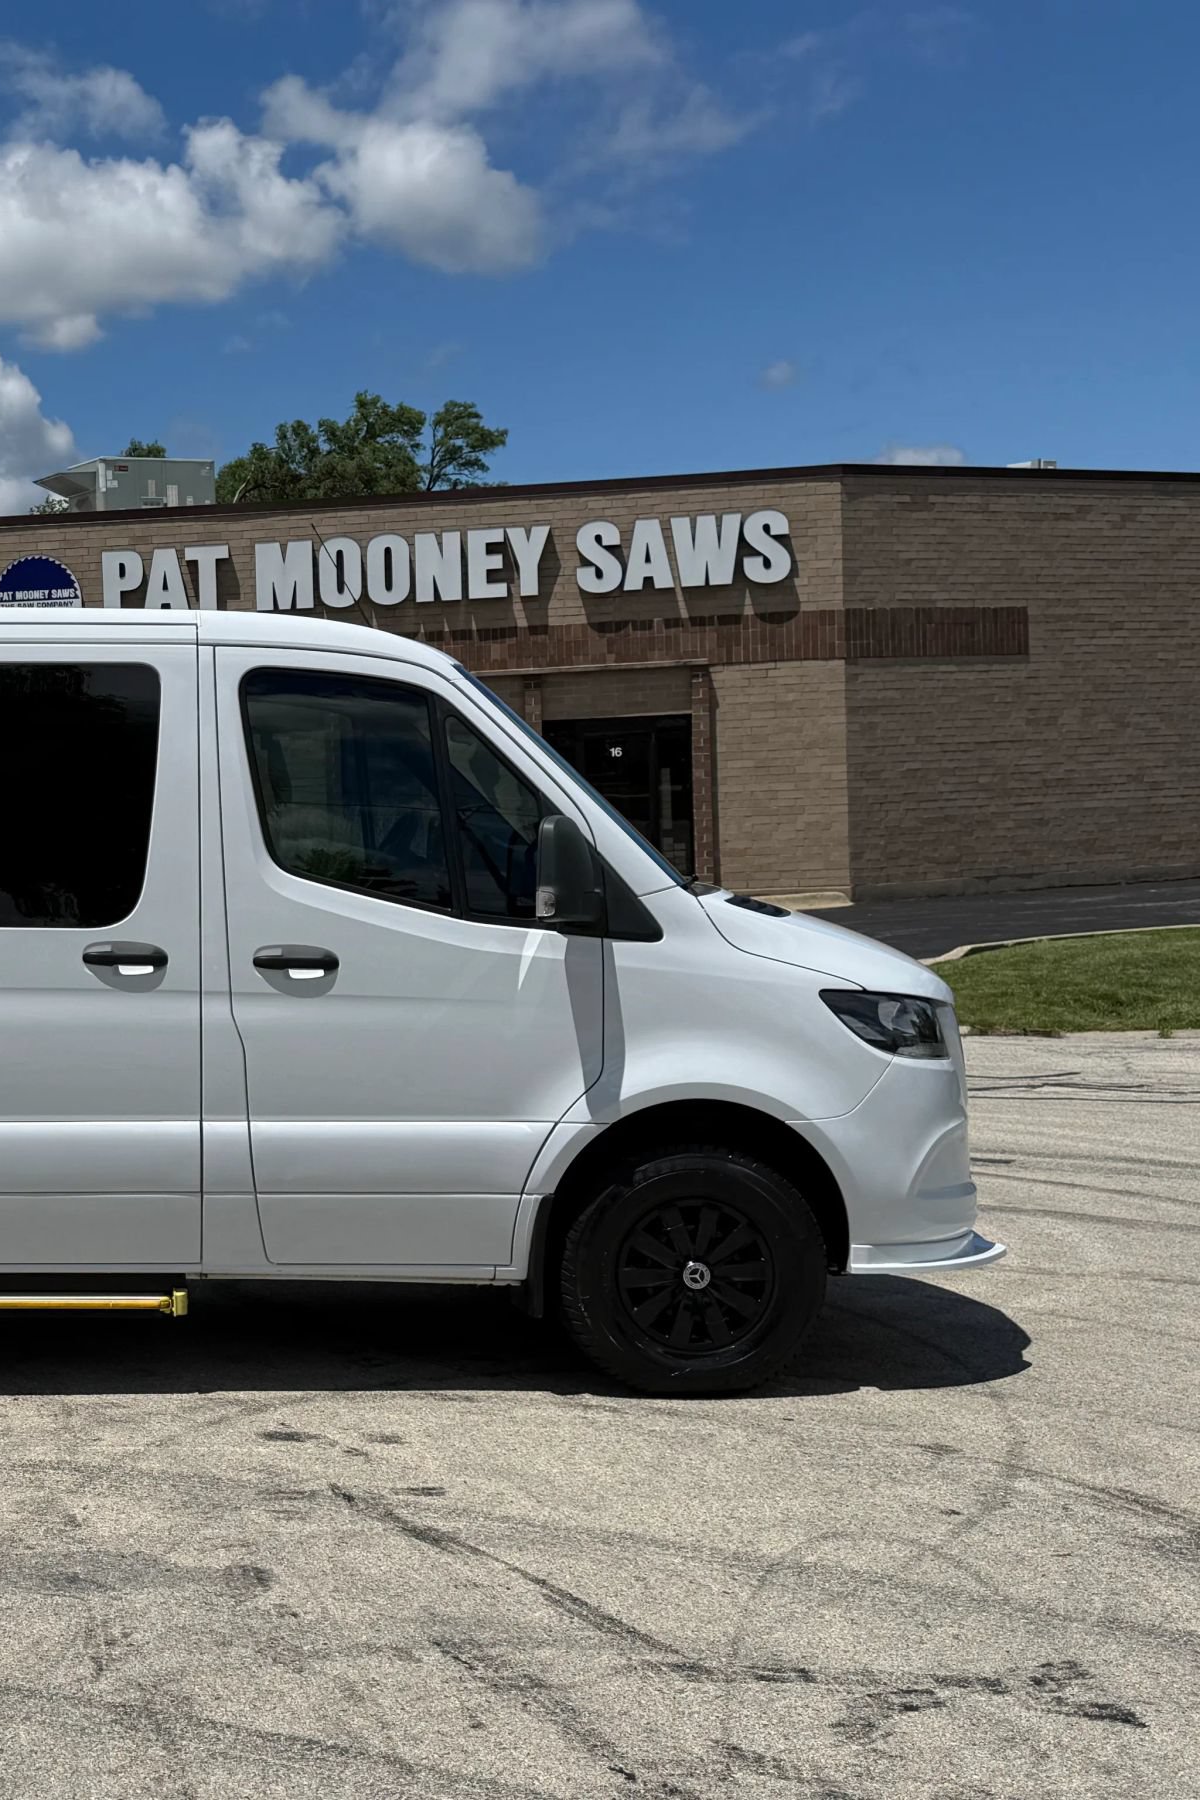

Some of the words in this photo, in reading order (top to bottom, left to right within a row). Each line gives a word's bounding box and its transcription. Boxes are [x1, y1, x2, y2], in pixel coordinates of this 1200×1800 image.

[101, 544, 229, 610] PAT
[254, 525, 550, 611] MOONEY
[576, 509, 791, 593] SAWS
[15, 589, 49, 600] MOONEY
[51, 588, 75, 599] SAWS
[609, 747, 622, 757] 16
